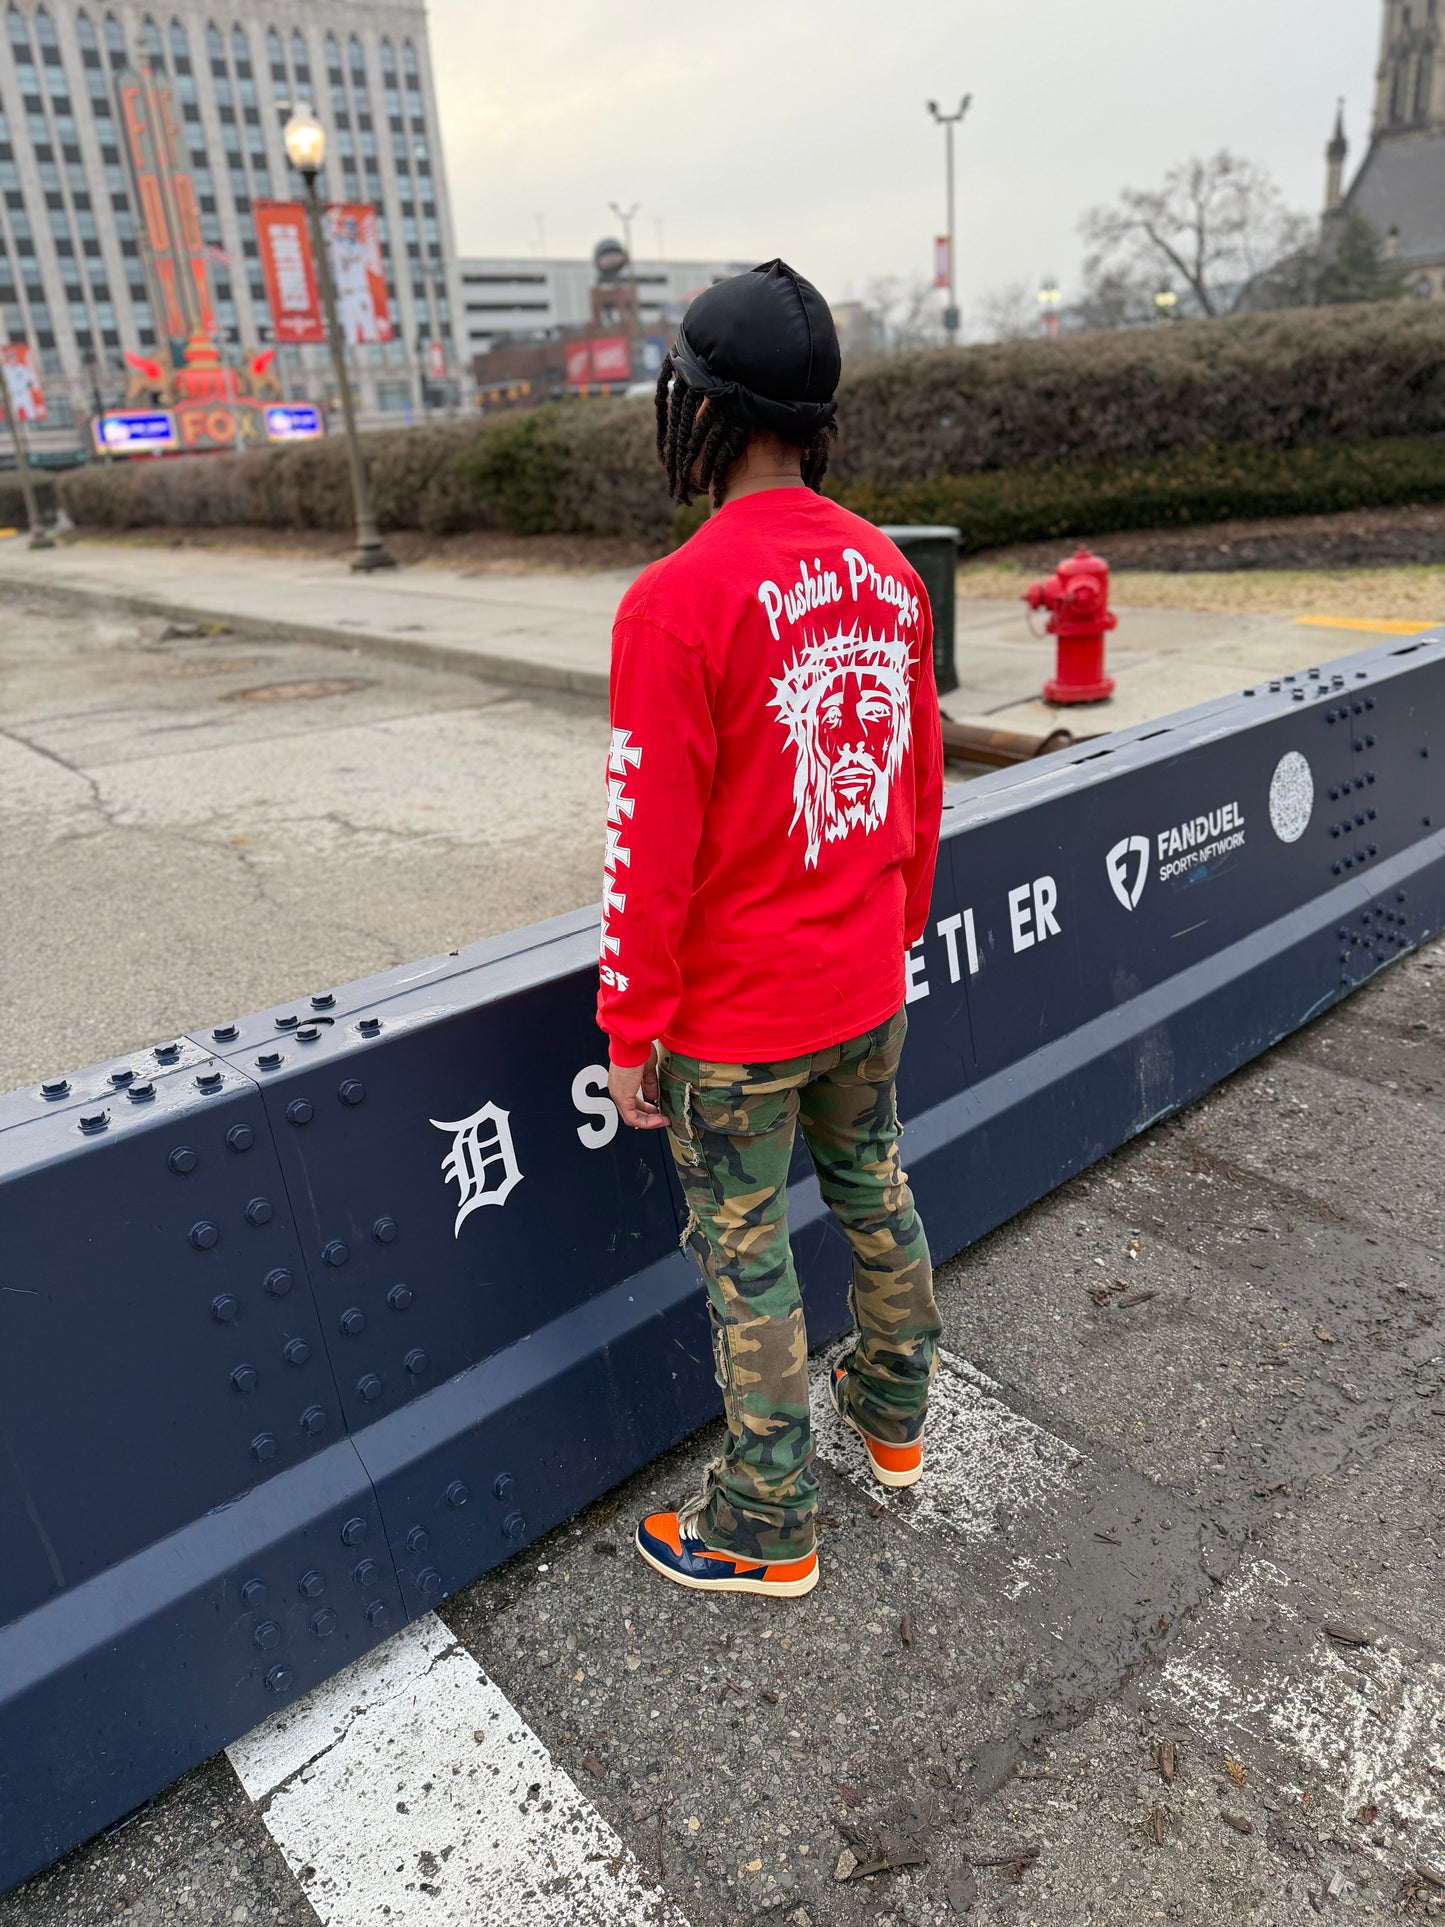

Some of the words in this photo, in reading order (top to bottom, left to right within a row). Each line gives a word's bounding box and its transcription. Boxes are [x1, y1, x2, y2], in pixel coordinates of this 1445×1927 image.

[180, 408, 257, 446] FOX
[758, 557, 843, 641] Pushin
[843, 548, 919, 628] Prays
[1157, 801, 1245, 861] FANDUEL
[1160, 852, 1199, 882] SPORTS
